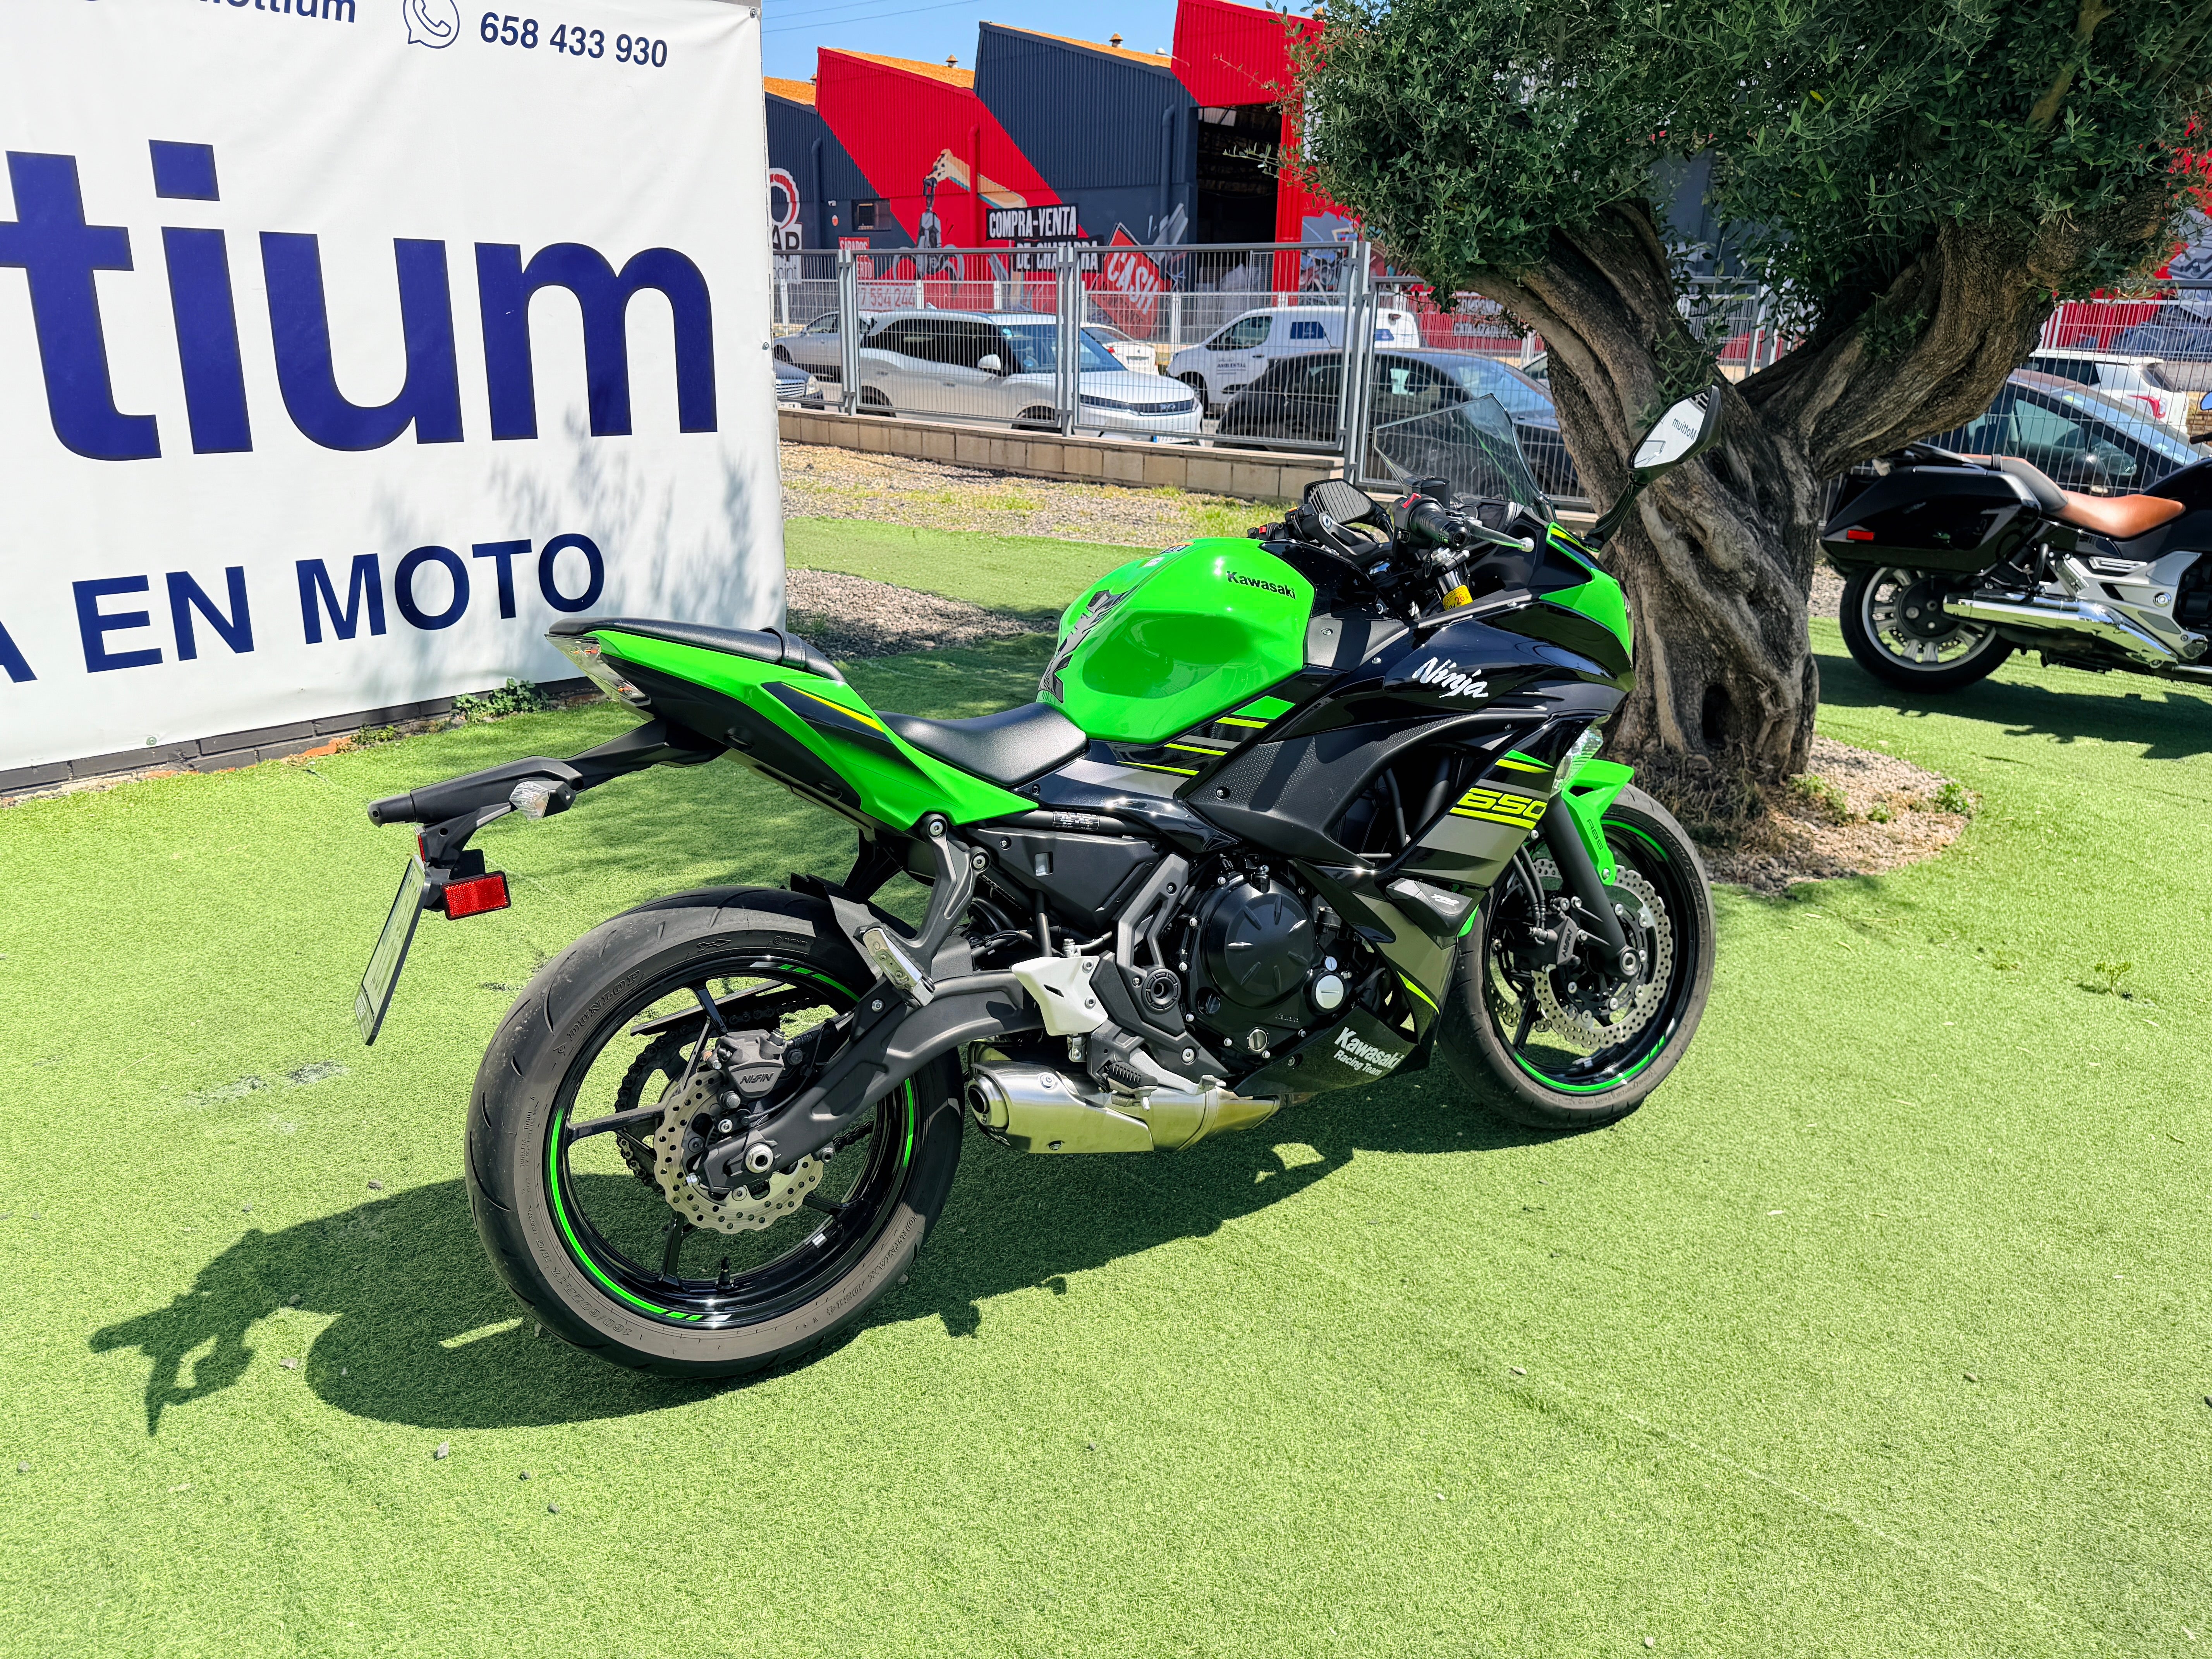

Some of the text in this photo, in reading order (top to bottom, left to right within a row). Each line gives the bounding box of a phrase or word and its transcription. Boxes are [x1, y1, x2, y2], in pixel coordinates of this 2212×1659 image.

[480, 12, 667, 68] 658 433 930
[989, 206, 1077, 238] COMPRA-VENTA
[1017, 241, 1099, 270] DE CHARA
[0, 139, 718, 461] tium
[1108, 252, 1159, 315] CASH
[72, 566, 254, 673] EN
[296, 533, 604, 644] MOTO
[1227, 571, 1296, 599] Kawasaki
[1455, 594, 1465, 605] 26
[1412, 657, 1489, 698] Ninja
[1457, 787, 1547, 820] 650
[1587, 819, 1603, 850] ABS
[567, 969, 641, 1042] DUNLOP
[1333, 1049, 1382, 1076] Racing Team
[1334, 1027, 1405, 1069] Kawasaki
